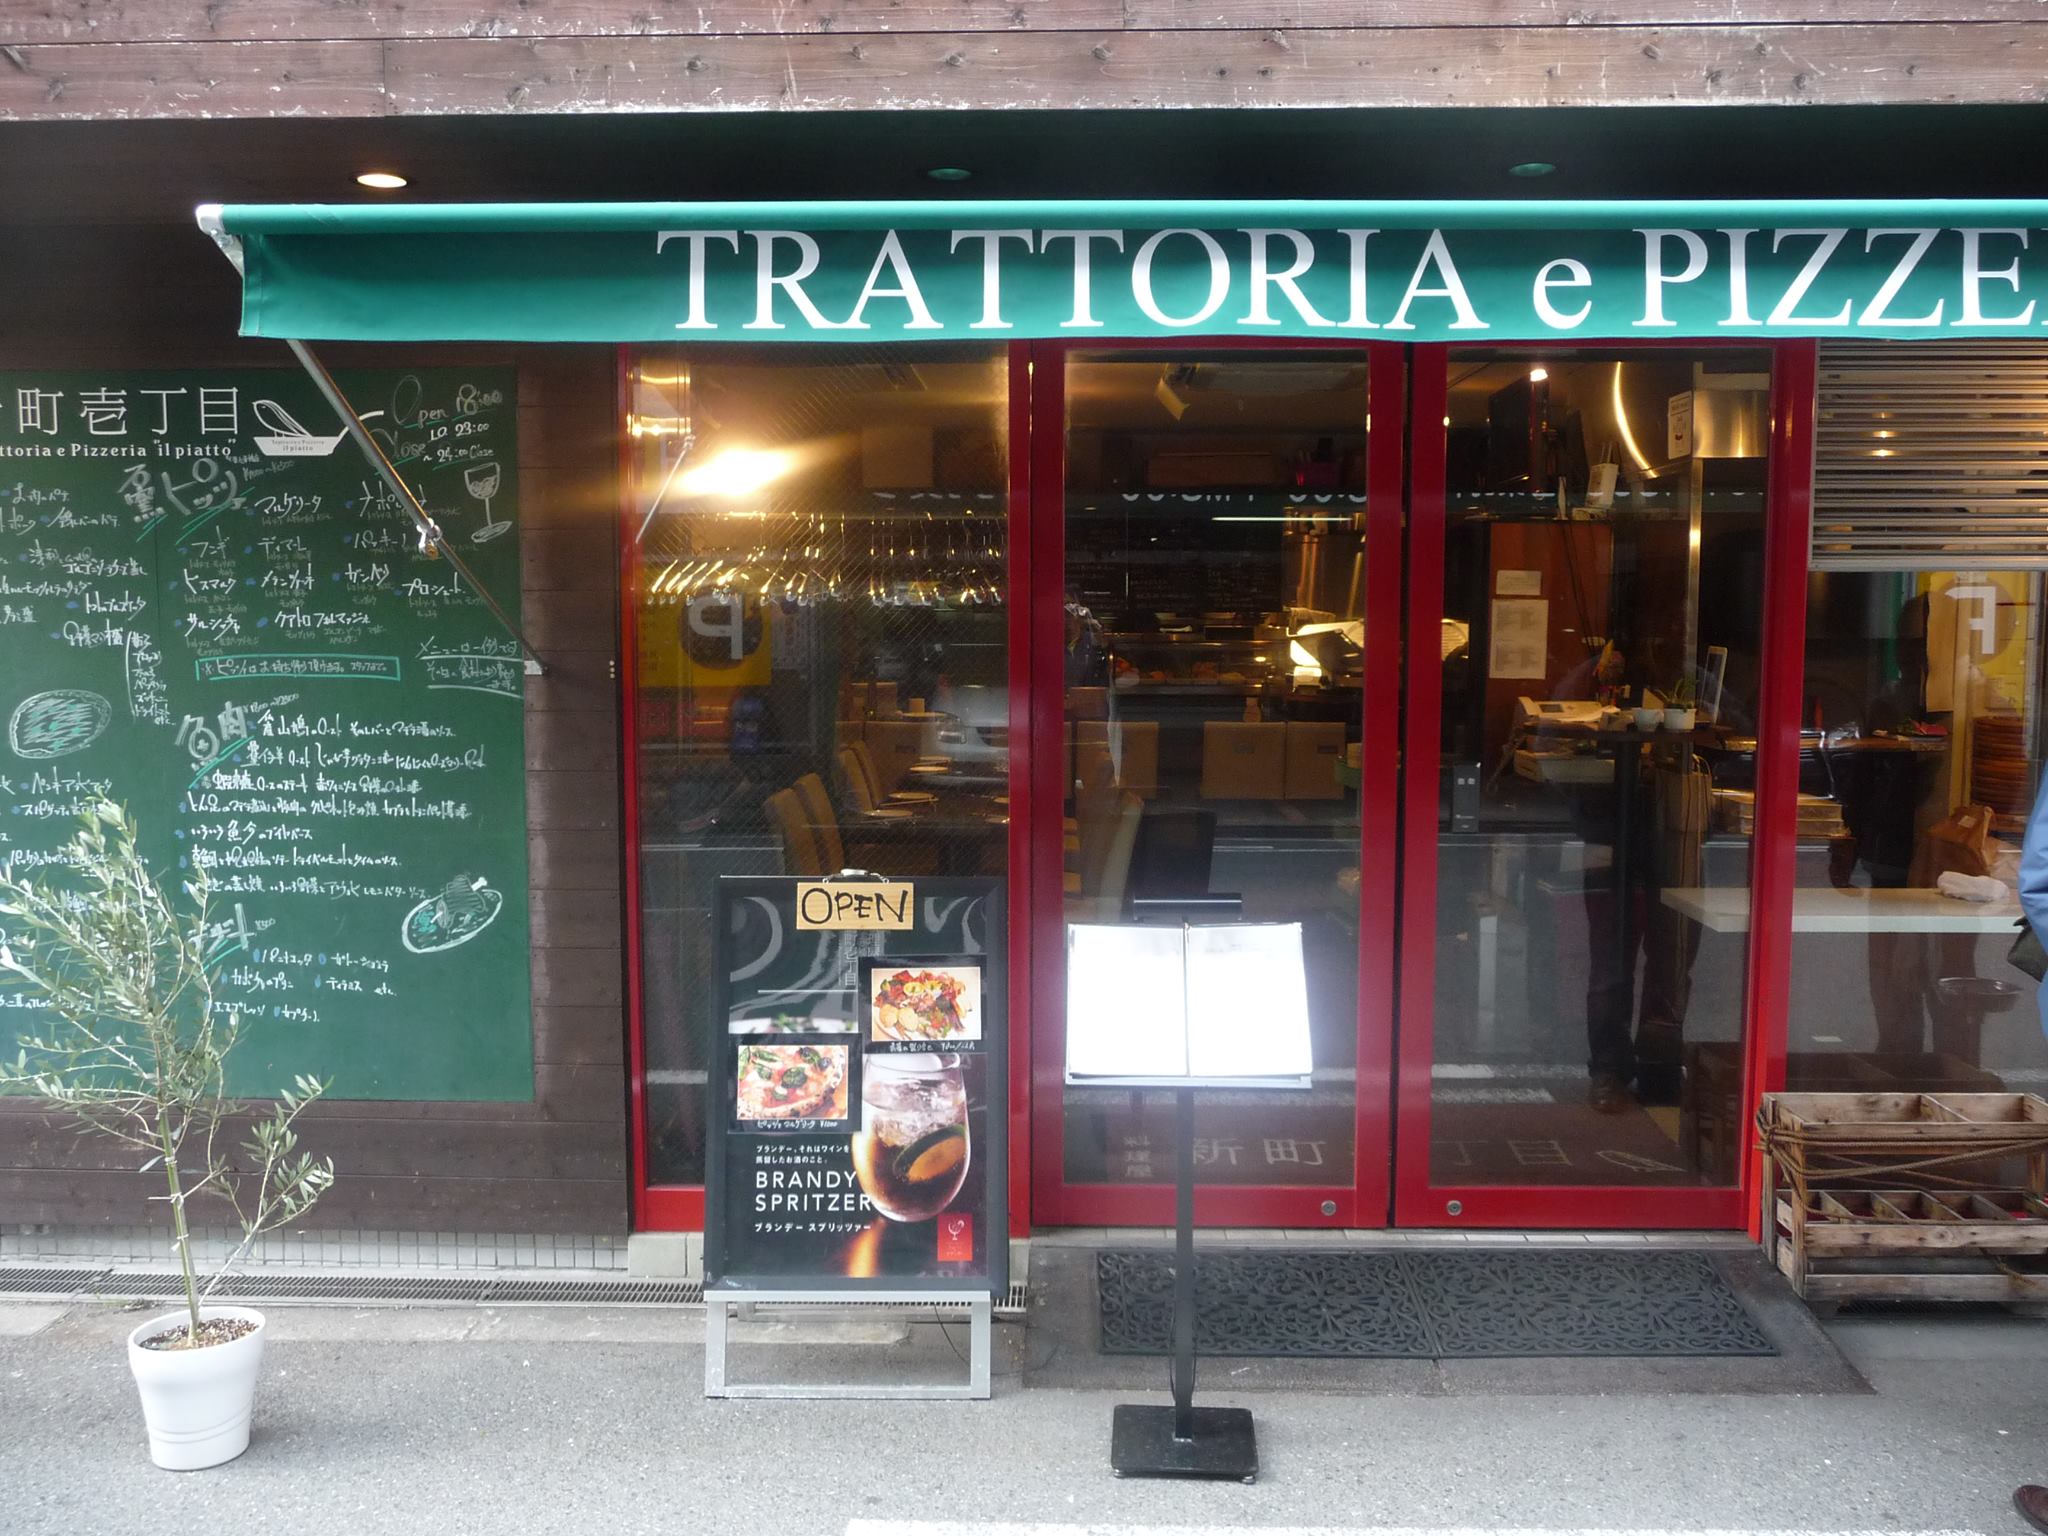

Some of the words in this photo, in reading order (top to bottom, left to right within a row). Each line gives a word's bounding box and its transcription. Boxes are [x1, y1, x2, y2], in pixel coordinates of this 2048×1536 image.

[657, 228, 1491, 330] TRATTORIA
[1532, 258, 1593, 330] e
[1631, 228, 2048, 329] PIZZE
[71, 443, 147, 458] Pizzeria
[802, 887, 909, 925] OPEN
[756, 1170, 857, 1189] BRANDY
[755, 1193, 872, 1212] SPRITZER
[755, 1222, 804, 1233] ブランデー
